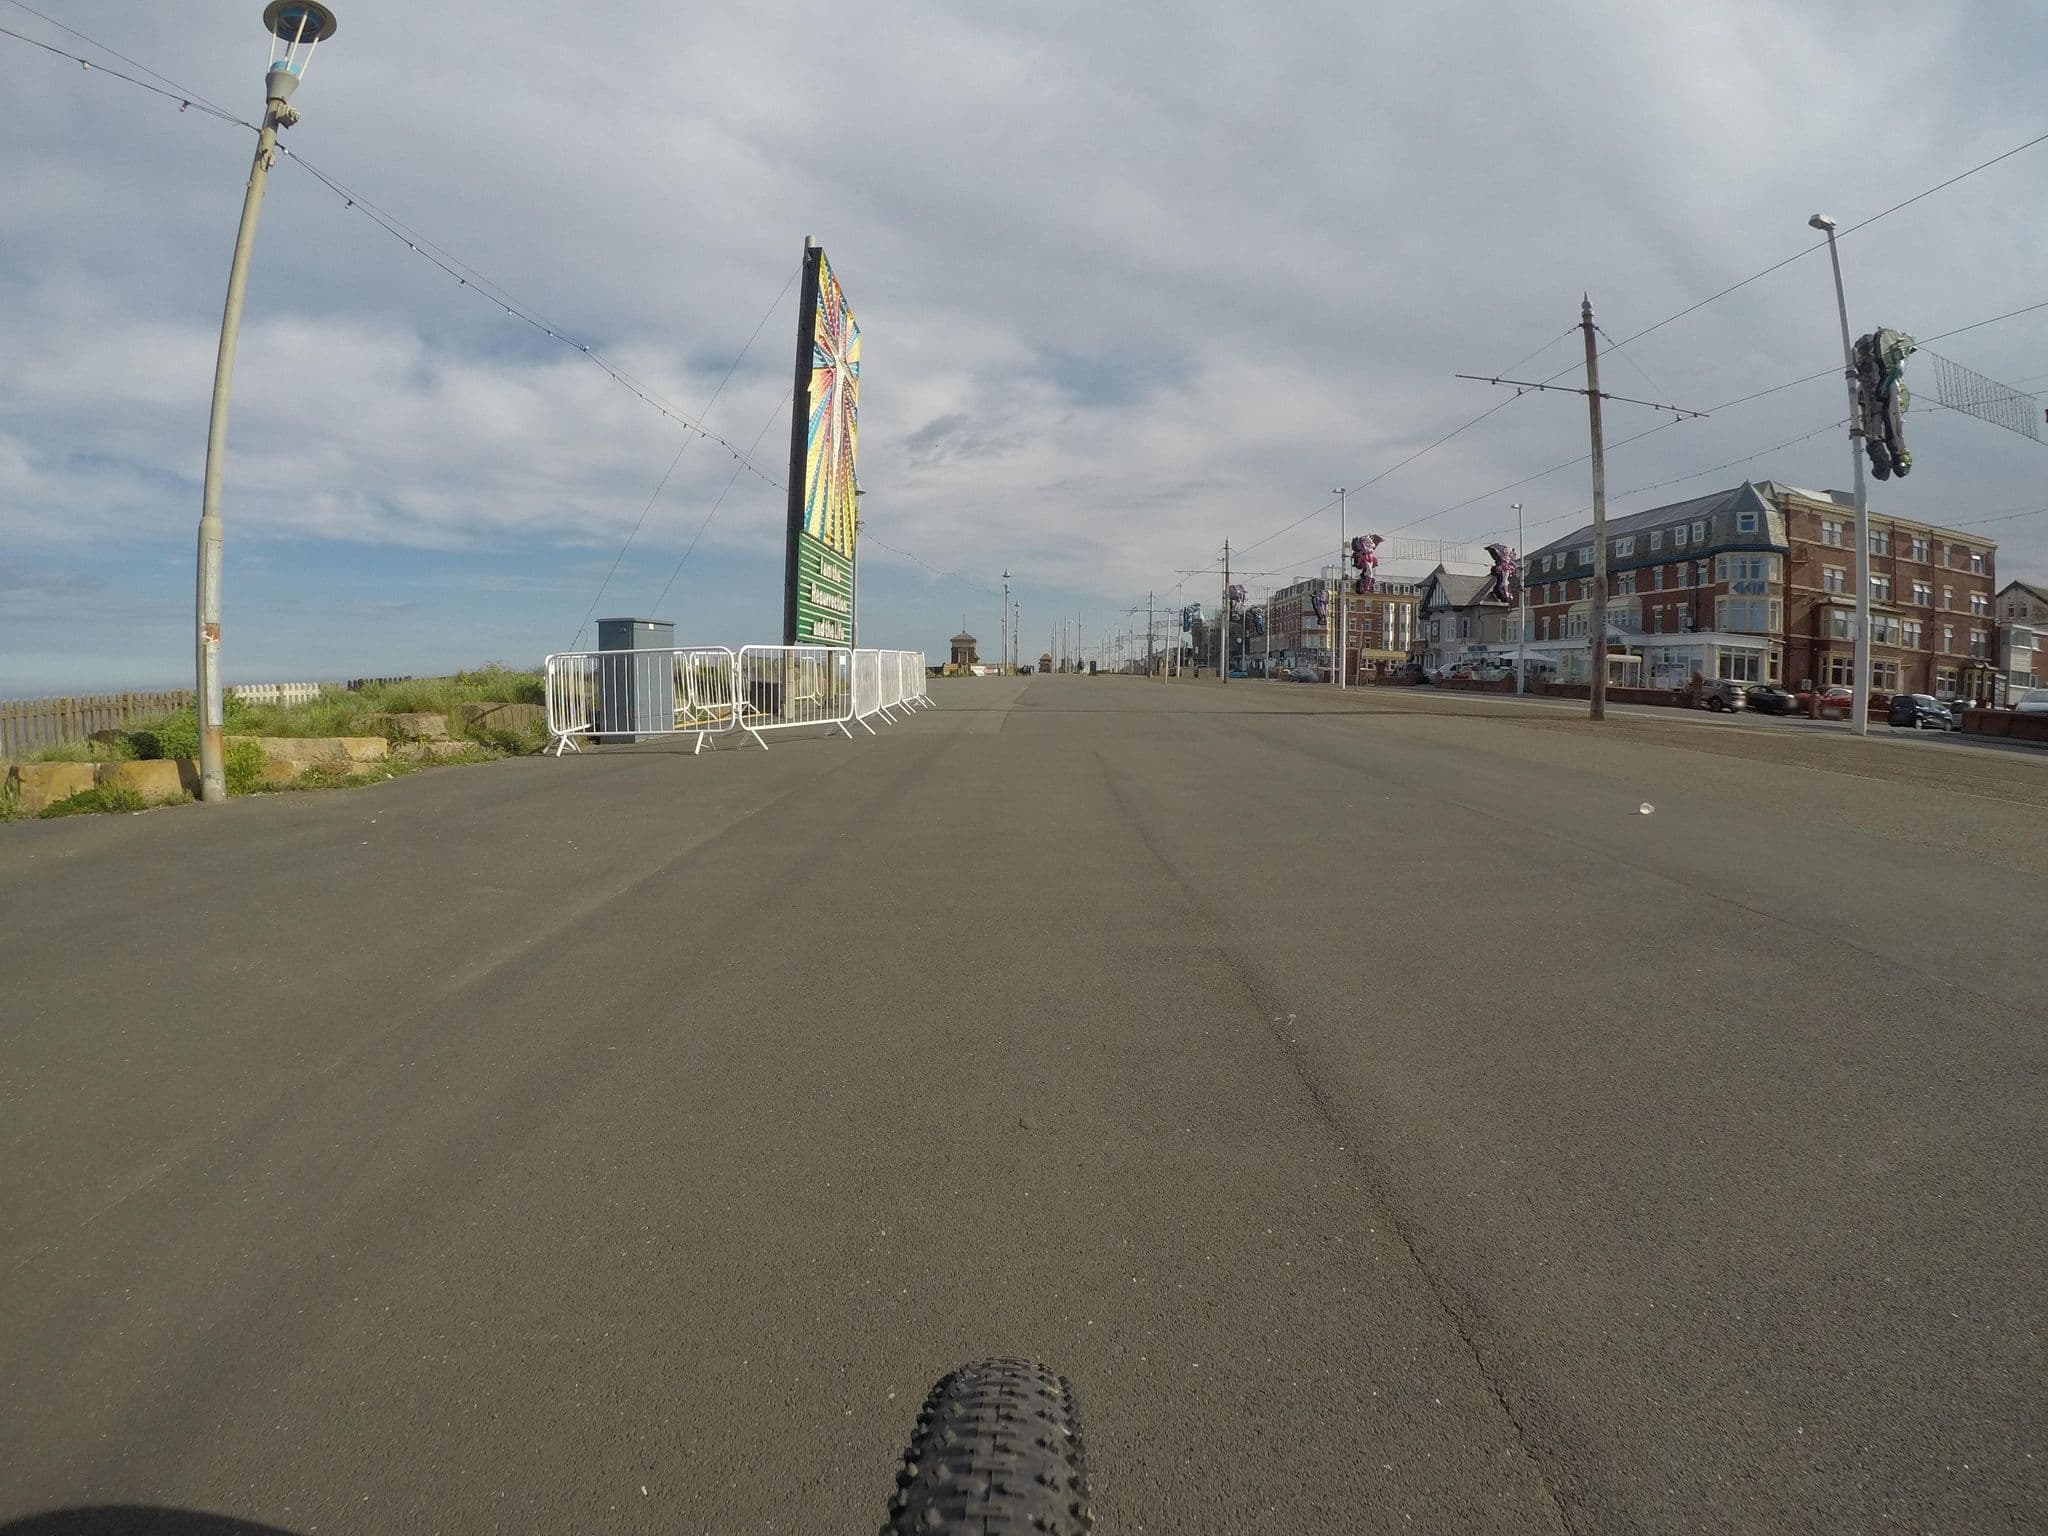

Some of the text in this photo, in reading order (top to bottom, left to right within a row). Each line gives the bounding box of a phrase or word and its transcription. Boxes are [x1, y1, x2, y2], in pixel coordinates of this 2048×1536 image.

[832, 564, 841, 583] the
[811, 583, 848, 612] Resurrection
[814, 618, 845, 641] and the Life
